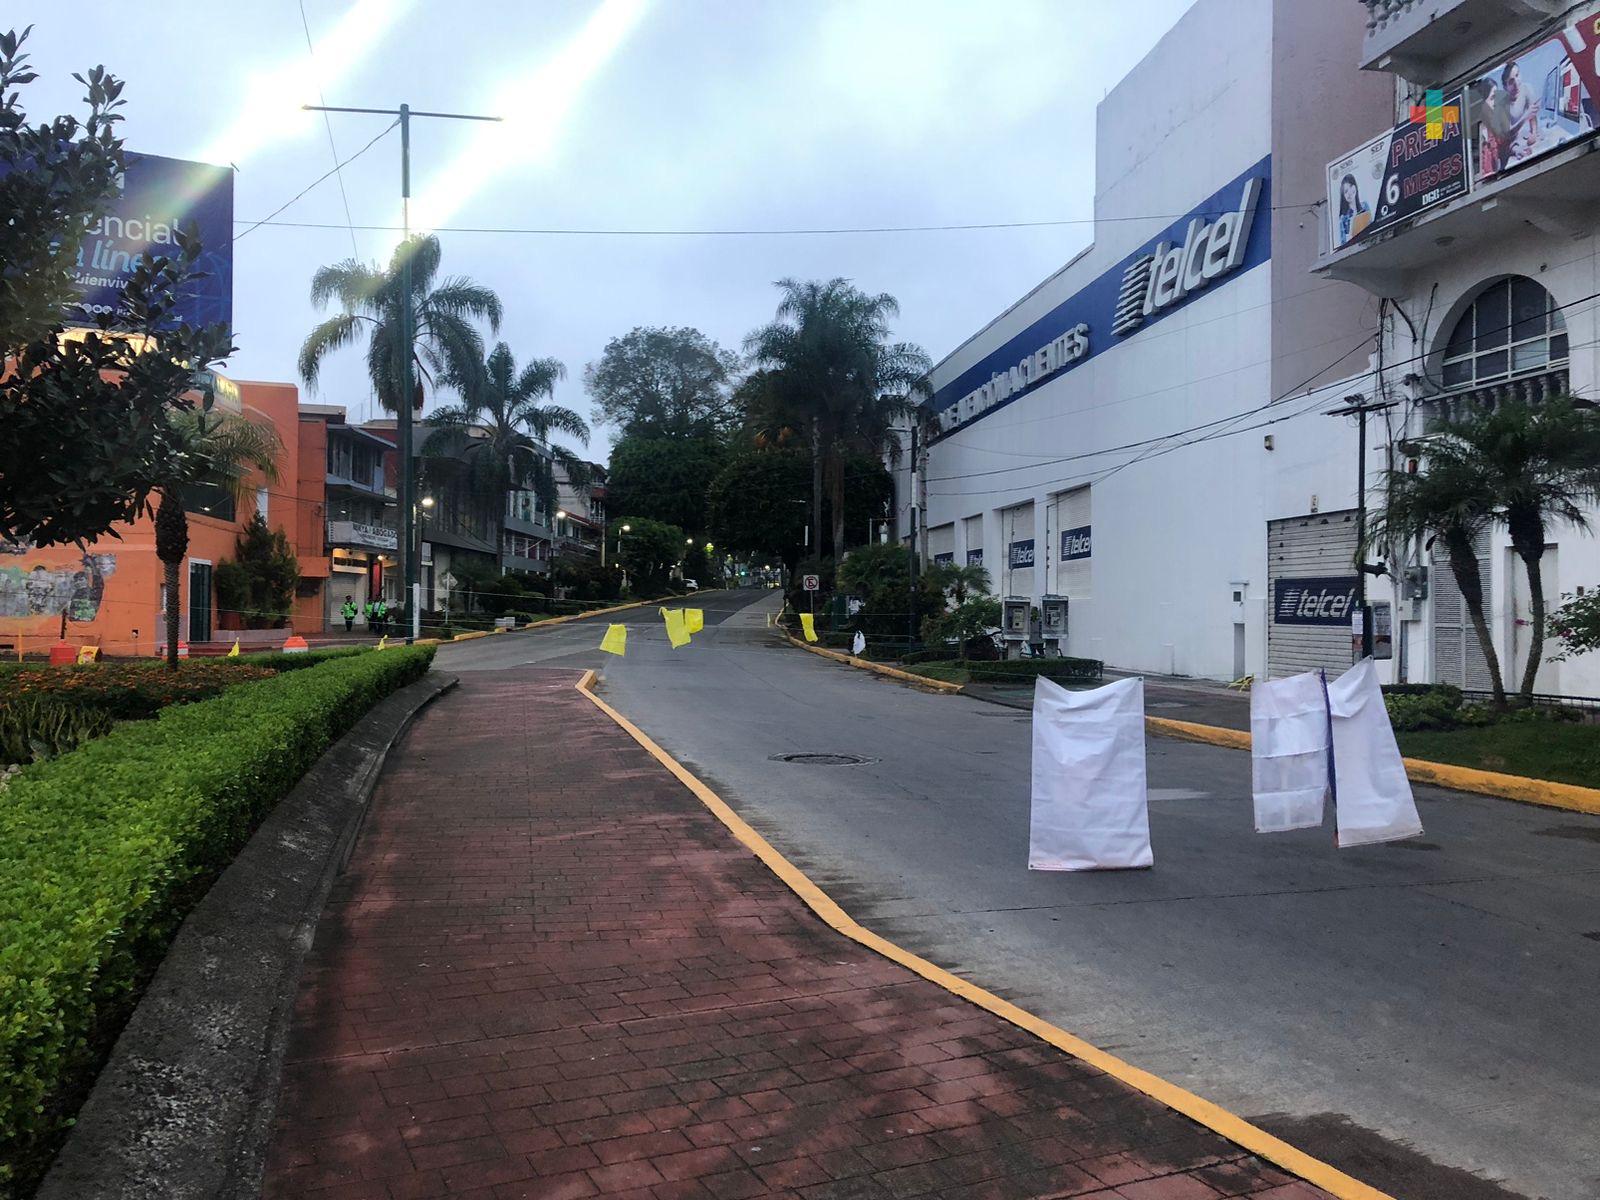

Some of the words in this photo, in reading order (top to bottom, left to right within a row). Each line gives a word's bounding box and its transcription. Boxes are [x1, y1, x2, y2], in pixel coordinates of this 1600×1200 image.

[1385, 172, 1400, 206] 6
[1403, 152, 1464, 199] MESES
[83, 212, 181, 247] encial
[1142, 176, 1264, 317] telcel
[1018, 322, 1090, 390] CLIENTES
[1296, 587, 1356, 618] telcel
